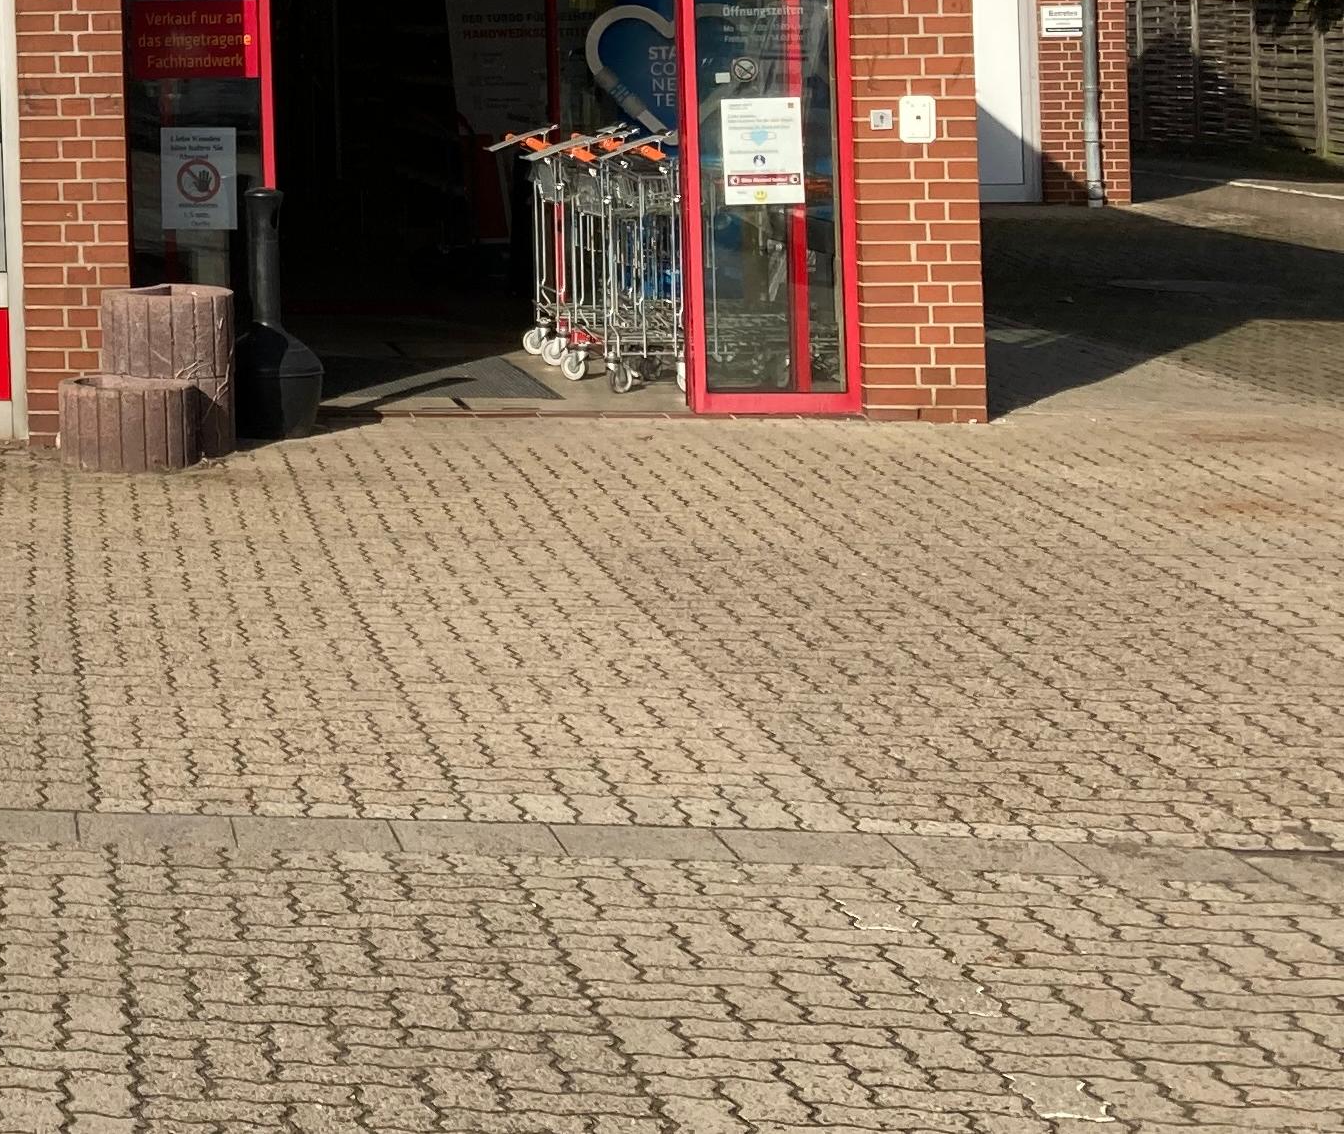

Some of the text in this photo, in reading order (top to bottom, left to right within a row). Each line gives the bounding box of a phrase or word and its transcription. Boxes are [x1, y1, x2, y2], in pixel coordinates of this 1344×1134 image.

[145, 11, 242, 26] Verkauf nur an
[138, 32, 252, 50] das eingetragene
[146, 53, 244, 69] Fachhandwerk
